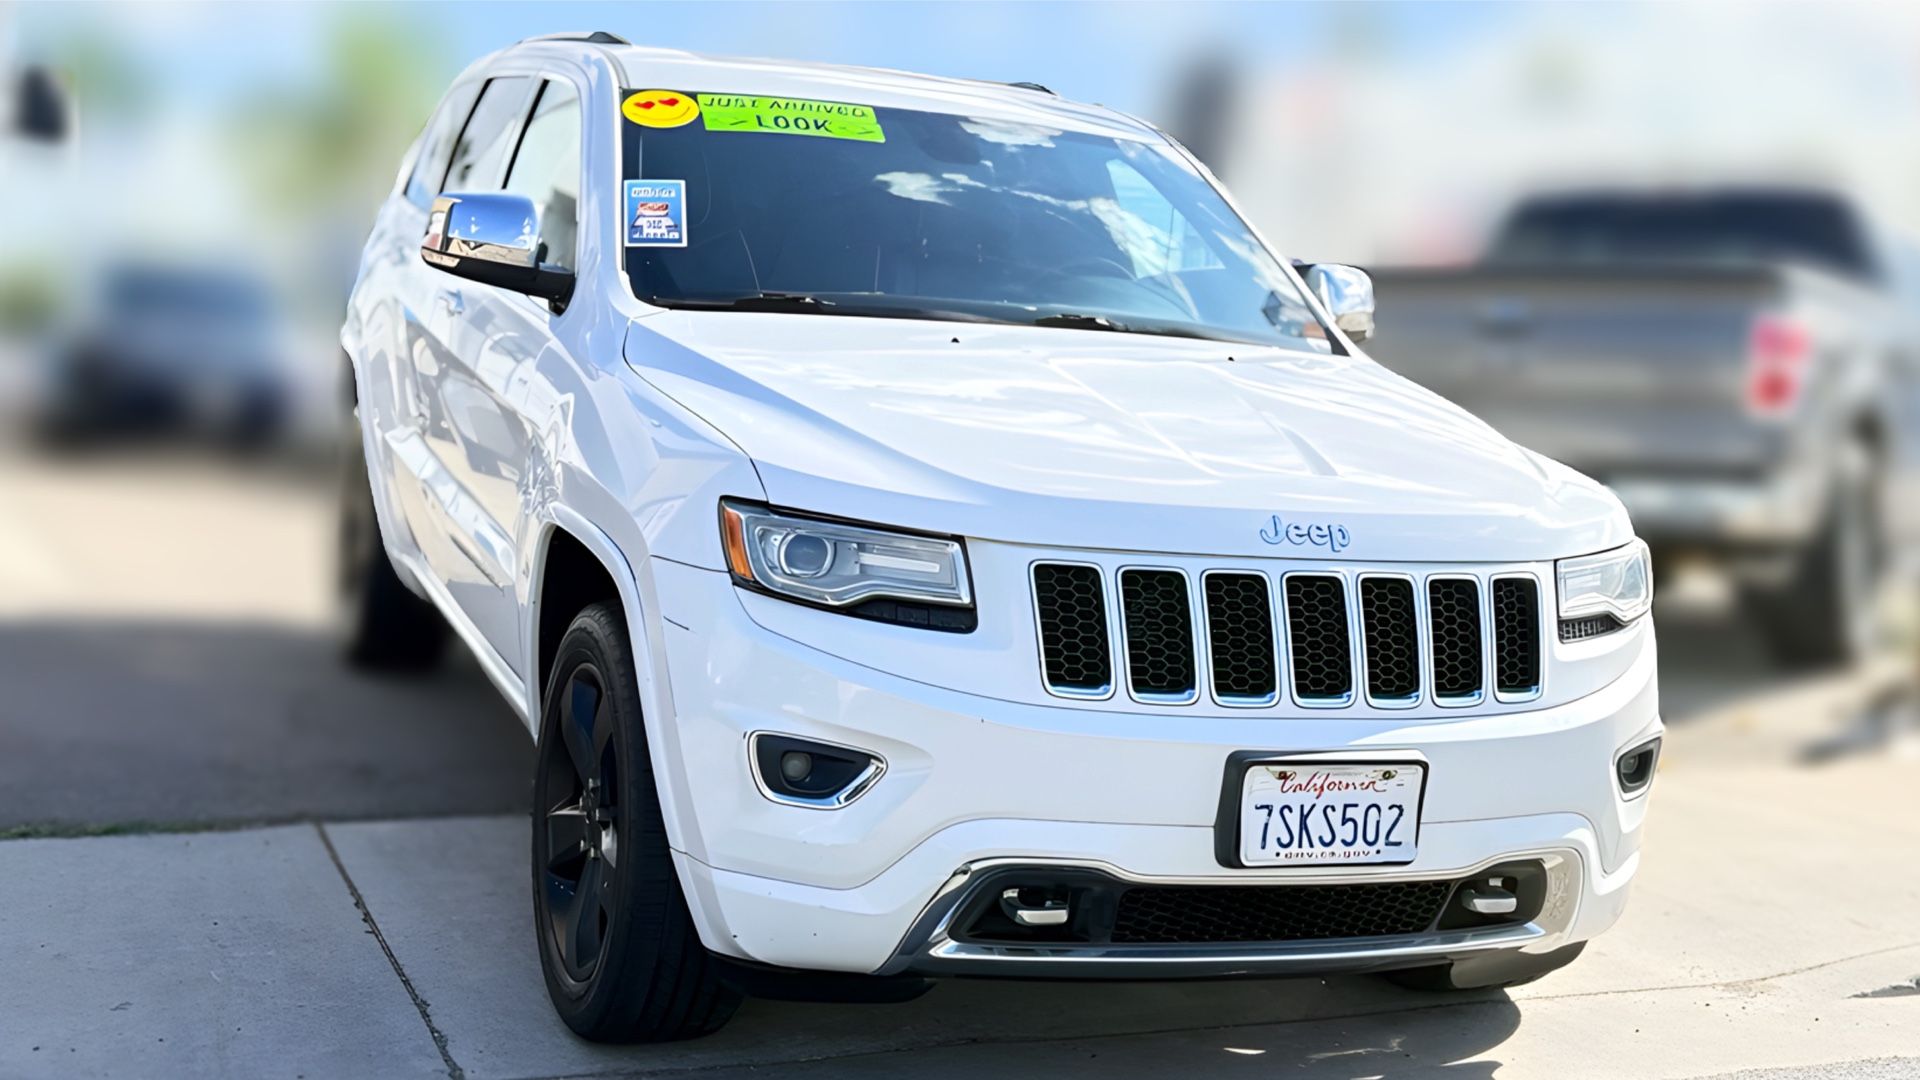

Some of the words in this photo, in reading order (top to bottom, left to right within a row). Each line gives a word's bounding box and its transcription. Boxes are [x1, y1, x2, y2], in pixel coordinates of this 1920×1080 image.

[755, 114, 833, 133] LOOK
[1260, 515, 1350, 553] Jeep
[1280, 770, 1387, 799] California
[1254, 803, 1405, 850] 7SKS502
